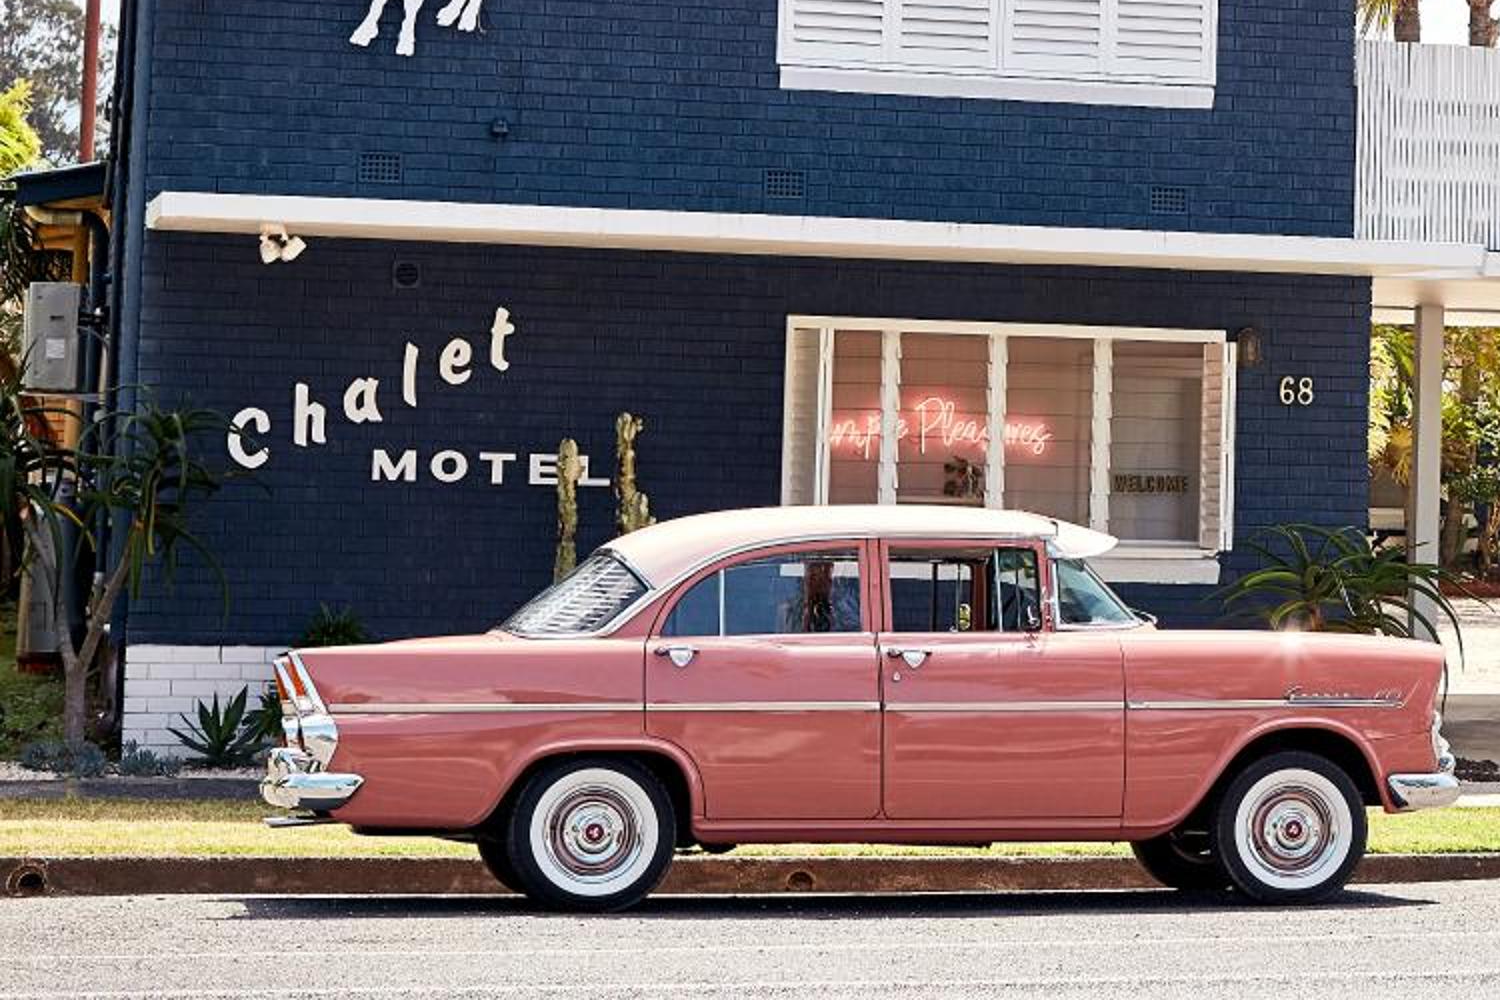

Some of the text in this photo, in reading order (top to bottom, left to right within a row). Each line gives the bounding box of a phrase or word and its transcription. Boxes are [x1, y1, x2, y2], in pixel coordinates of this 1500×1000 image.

[1280, 376, 1313, 405] 68
[371, 450, 611, 487] MOTEL
[1113, 475, 1188, 493] WELCOME
